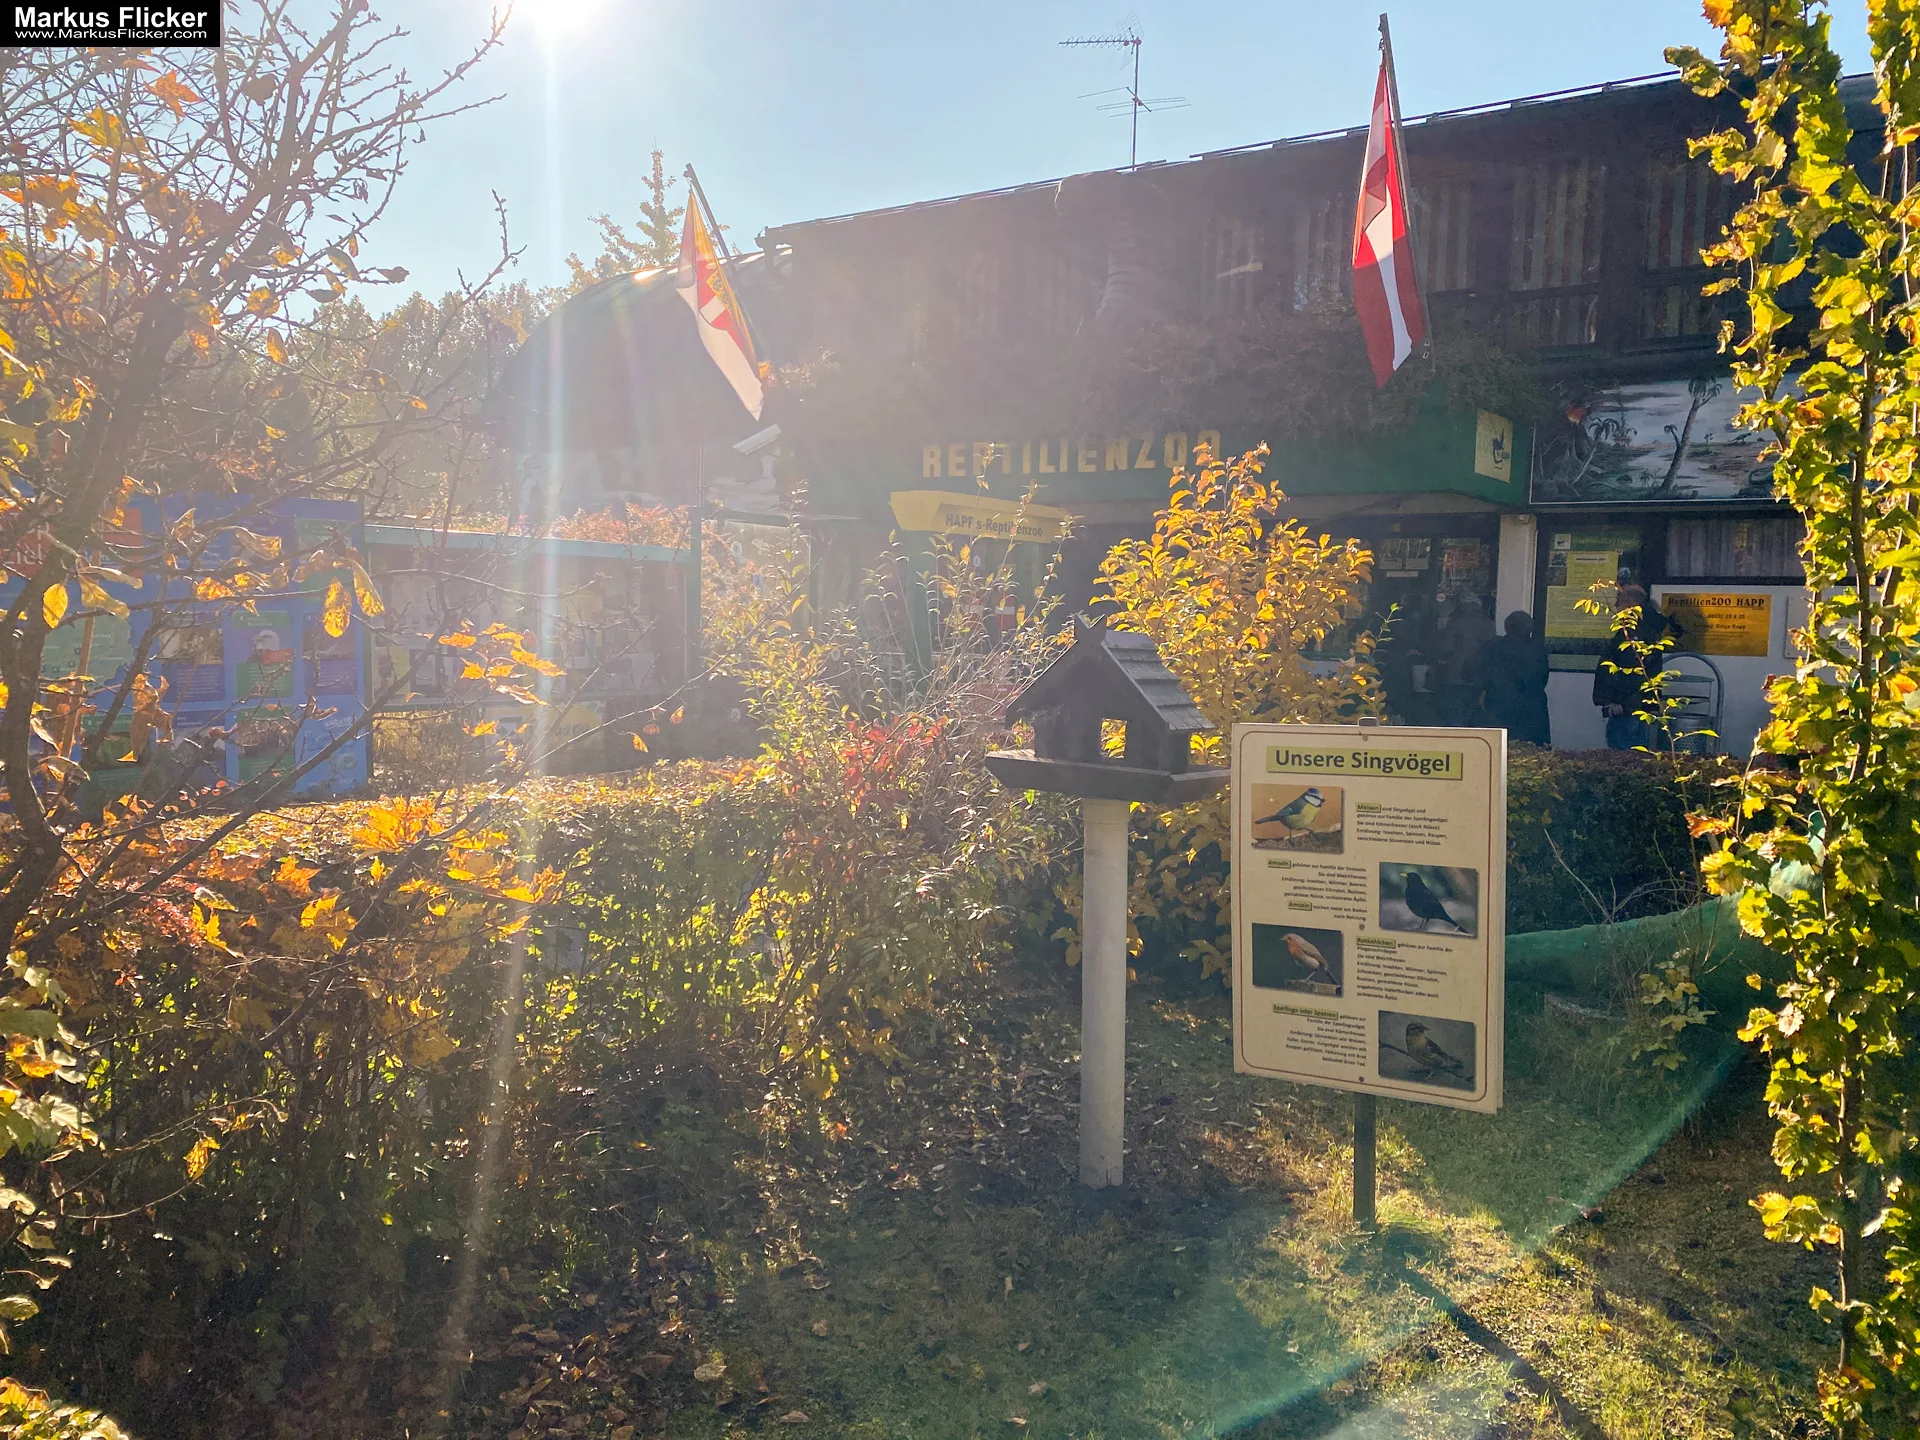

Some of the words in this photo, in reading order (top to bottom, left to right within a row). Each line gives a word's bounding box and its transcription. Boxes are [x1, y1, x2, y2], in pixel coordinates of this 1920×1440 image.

[922, 429, 1221, 478] REPTILIENZOO
[1736, 598, 1765, 608] HAPP
[1275, 749, 1345, 768] Unsere
[1351, 751, 1450, 775] Singvögel
